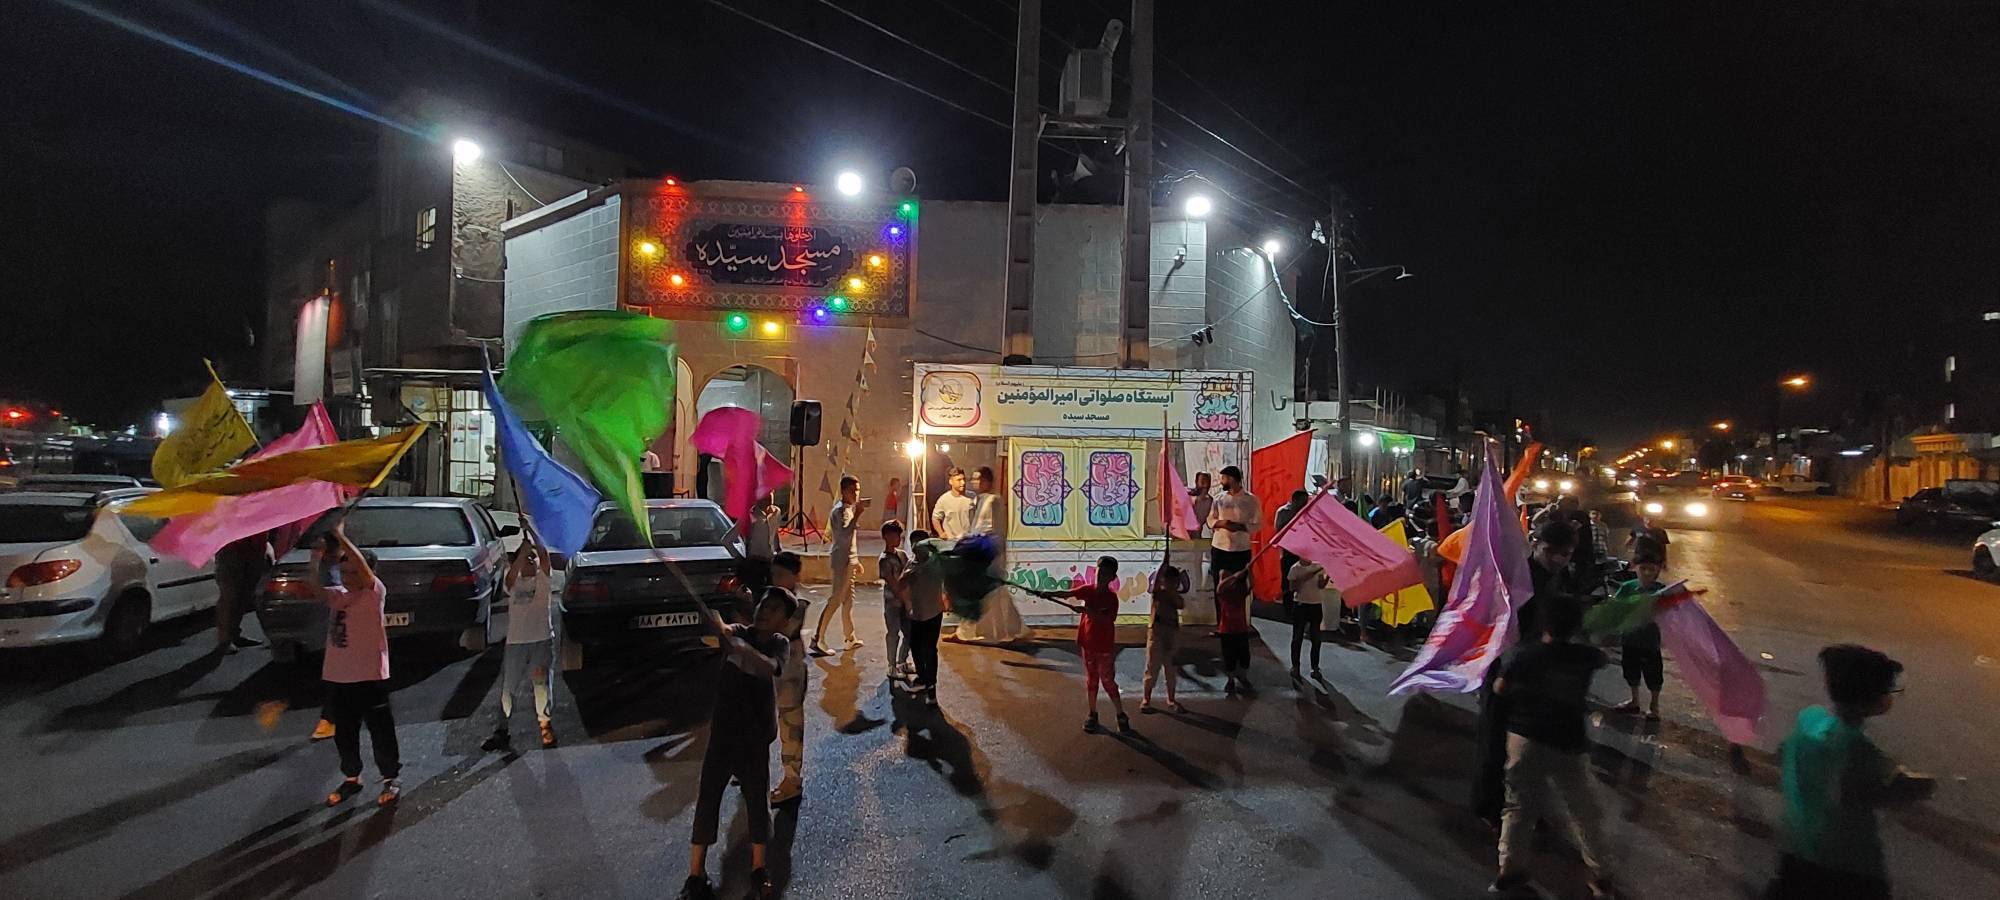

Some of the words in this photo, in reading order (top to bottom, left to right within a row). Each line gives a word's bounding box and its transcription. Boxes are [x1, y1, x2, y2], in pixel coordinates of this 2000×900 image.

[768, 244, 841, 275] مسجد
[1079, 389, 1124, 407] صلواتی
[1127, 388, 1174, 407] ایستگاه
[1063, 413, 1084, 422] سیده
[1085, 413, 1110, 422] مسجد
[1023, 503, 1062, 524] الله
[1091, 503, 1129, 524] الله
